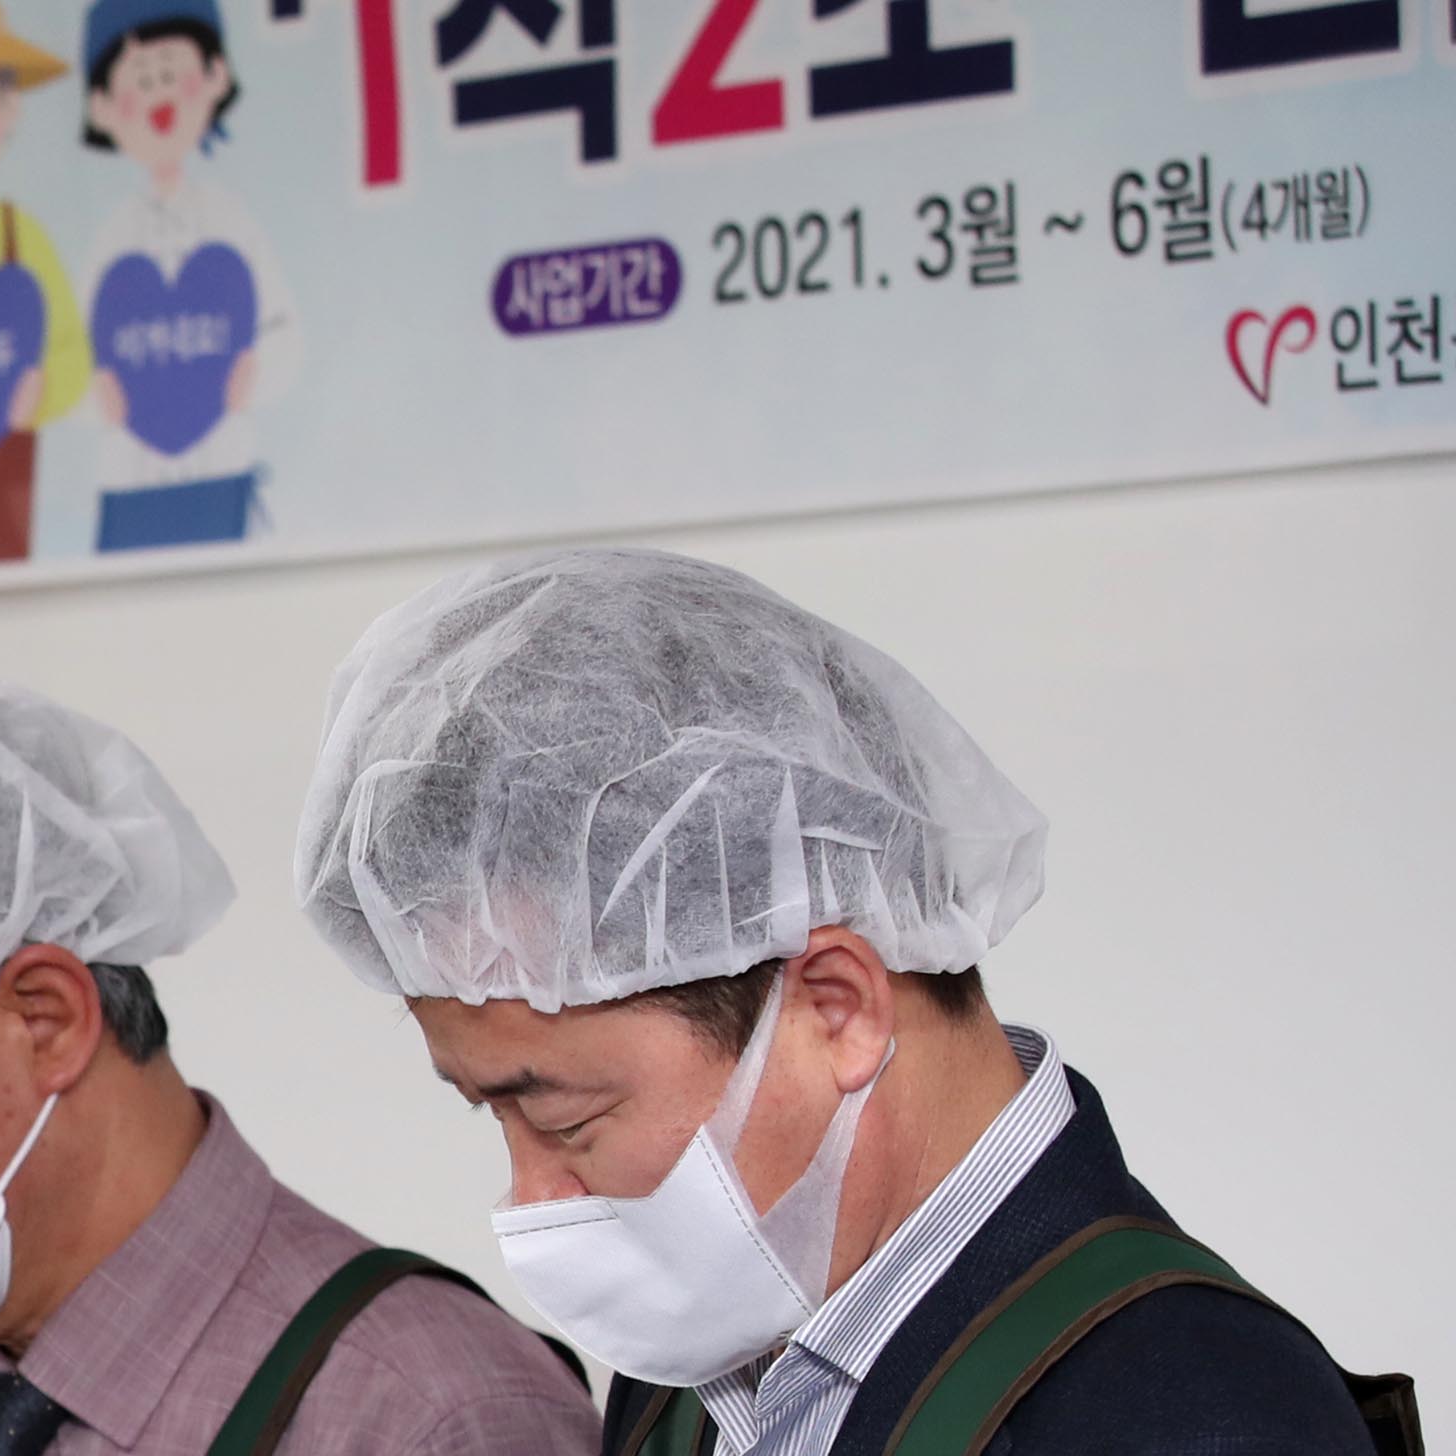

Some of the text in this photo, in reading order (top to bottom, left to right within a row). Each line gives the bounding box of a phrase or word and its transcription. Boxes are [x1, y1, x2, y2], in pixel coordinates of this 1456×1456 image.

[507, 244, 666, 328] 사업기간
[711, 209, 891, 304] 2021.
[914, 179, 1020, 289] 3월
[1330, 293, 1456, 392] 인천
